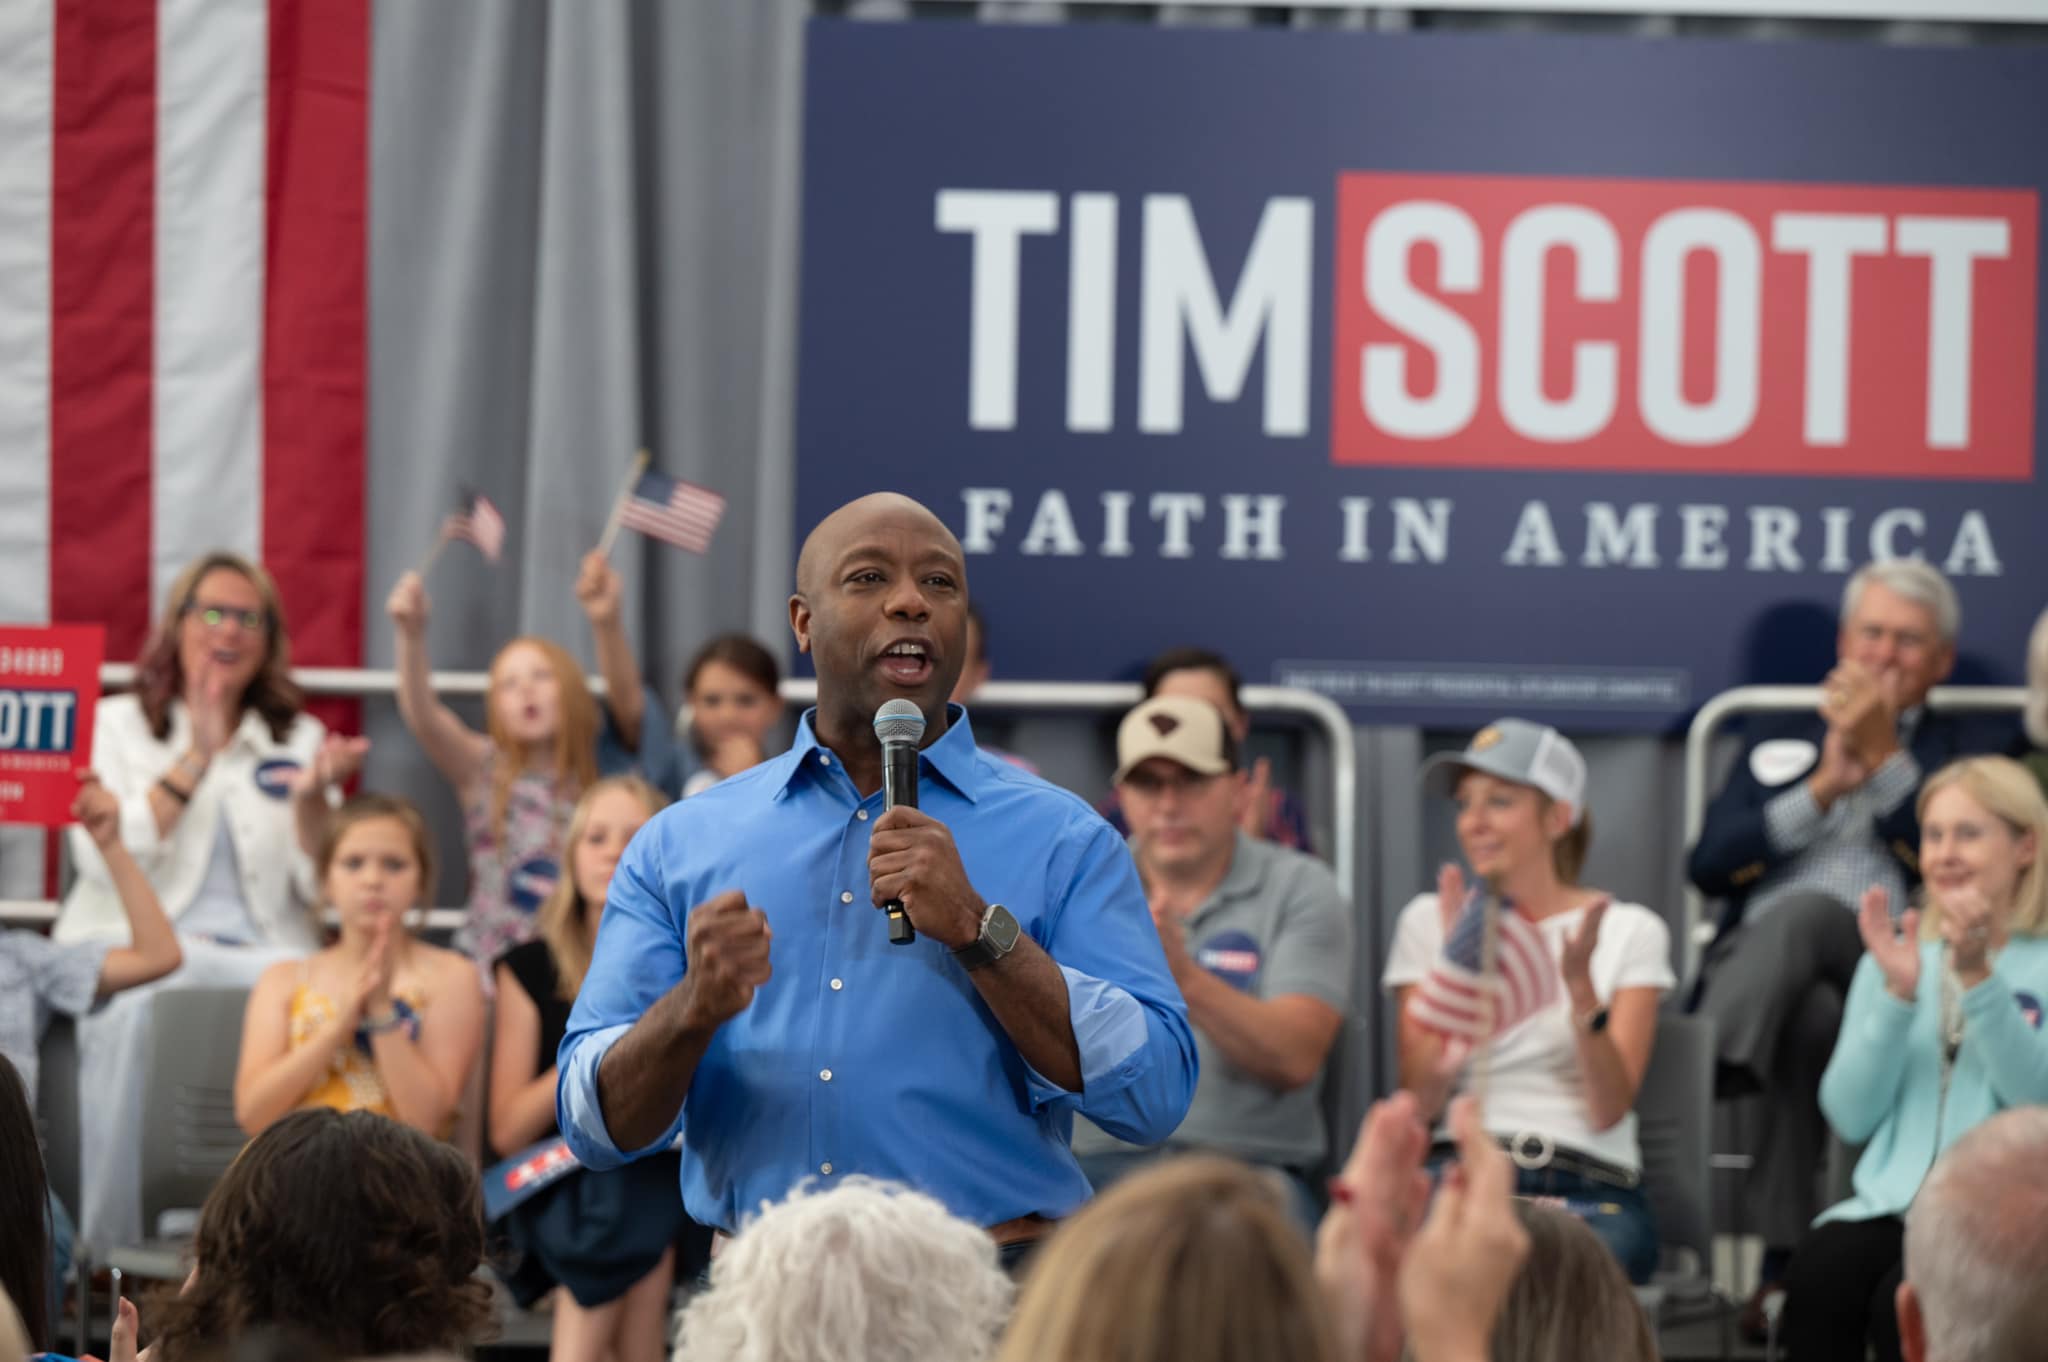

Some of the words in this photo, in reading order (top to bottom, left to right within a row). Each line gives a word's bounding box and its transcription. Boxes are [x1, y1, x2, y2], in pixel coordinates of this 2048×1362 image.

[935, 189, 1314, 436] TIM
[1361, 200, 2010, 448] SCOTT
[962, 489, 1286, 561] FAITH
[1340, 497, 1451, 564] IN
[1504, 503, 2003, 576] AMERICA
